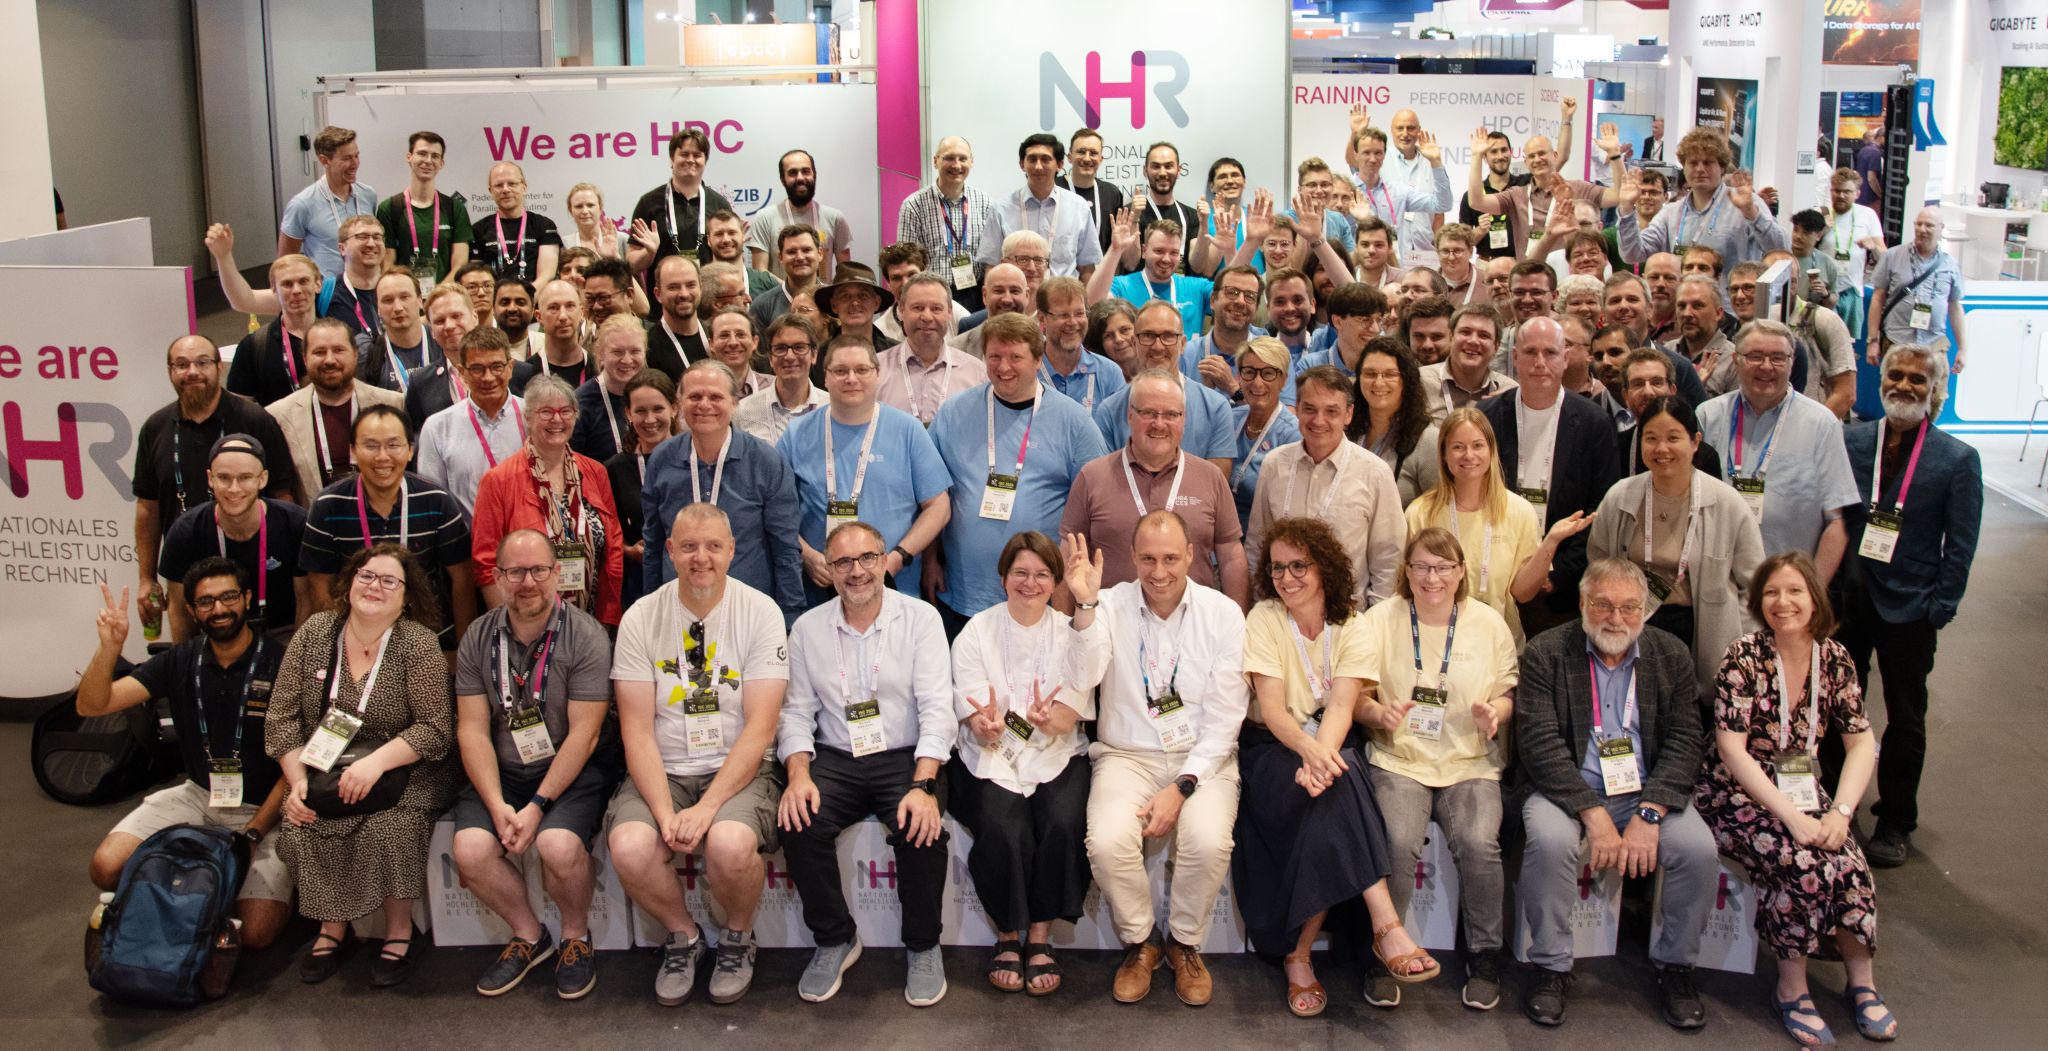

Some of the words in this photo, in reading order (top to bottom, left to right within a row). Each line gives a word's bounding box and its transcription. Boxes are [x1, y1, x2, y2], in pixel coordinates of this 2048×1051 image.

[1700, 14, 1731, 28] GIGABYTE
[1740, 12, 1756, 27] AMD
[1829, 21, 1852, 30] Data
[1854, 21, 1889, 31] Storage
[1891, 22, 1904, 30] for
[1990, 17, 2037, 31] GIGABYTE
[1039, 49, 1191, 131] NHR
[1294, 86, 1391, 105] RAINING
[1409, 91, 1526, 106] PERFORMANCE
[1482, 115, 1530, 135] HPC
[1532, 116, 1559, 139] METHOD
[483, 126, 556, 161] We
[568, 132, 638, 159] are
[734, 188, 760, 202] ZIB
[472, 204, 497, 213] Paralle
[0, 344, 22, 379] e
[37, 345, 119, 380] are
[0, 516, 119, 538] ATIONALES
[0, 540, 139, 564] CHLEISTUNG
[5, 564, 108, 585] RECHNEN
